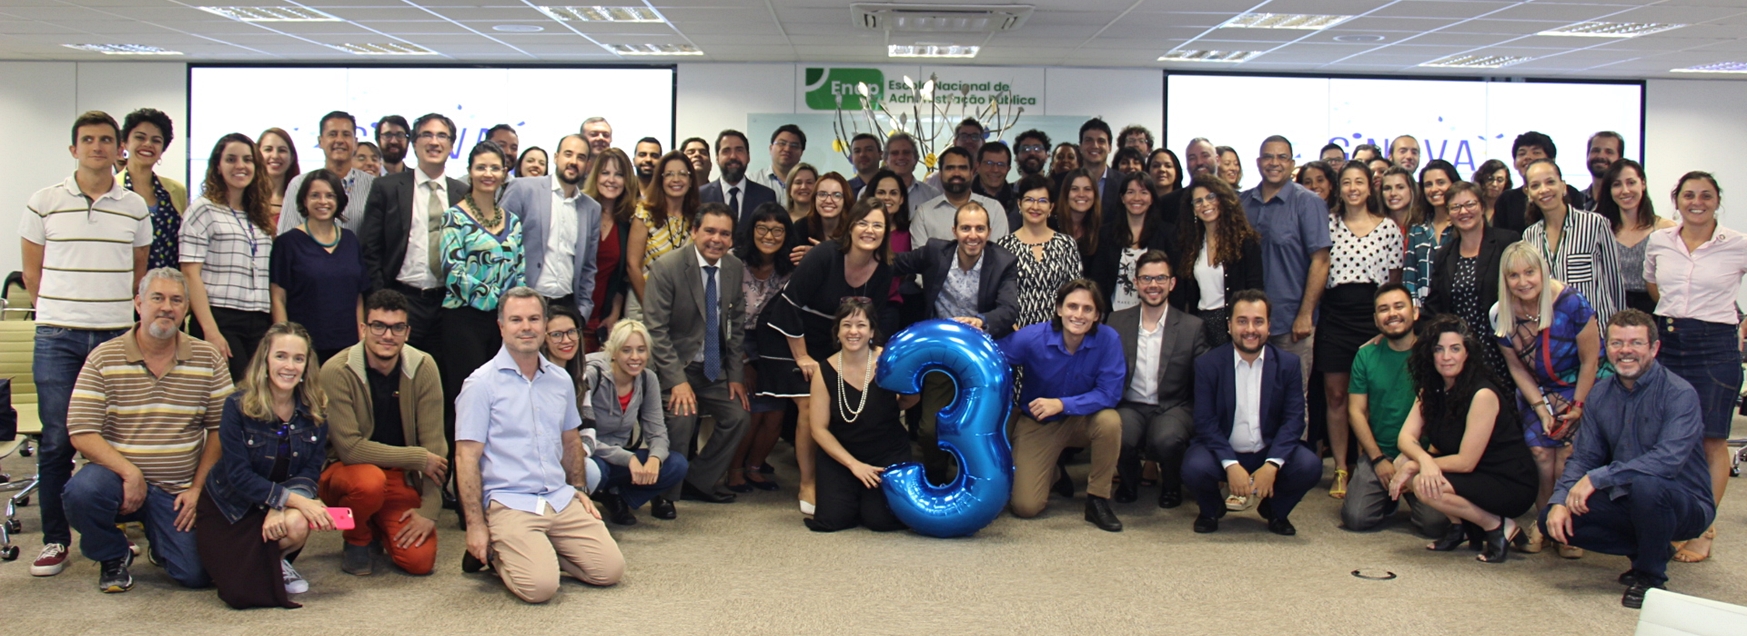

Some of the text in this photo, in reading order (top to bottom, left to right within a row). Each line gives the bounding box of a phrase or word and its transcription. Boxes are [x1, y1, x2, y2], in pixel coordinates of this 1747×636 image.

[889, 80, 930, 90] Escol
[993, 81, 1010, 92] de
[876, 319, 1014, 538] 3
